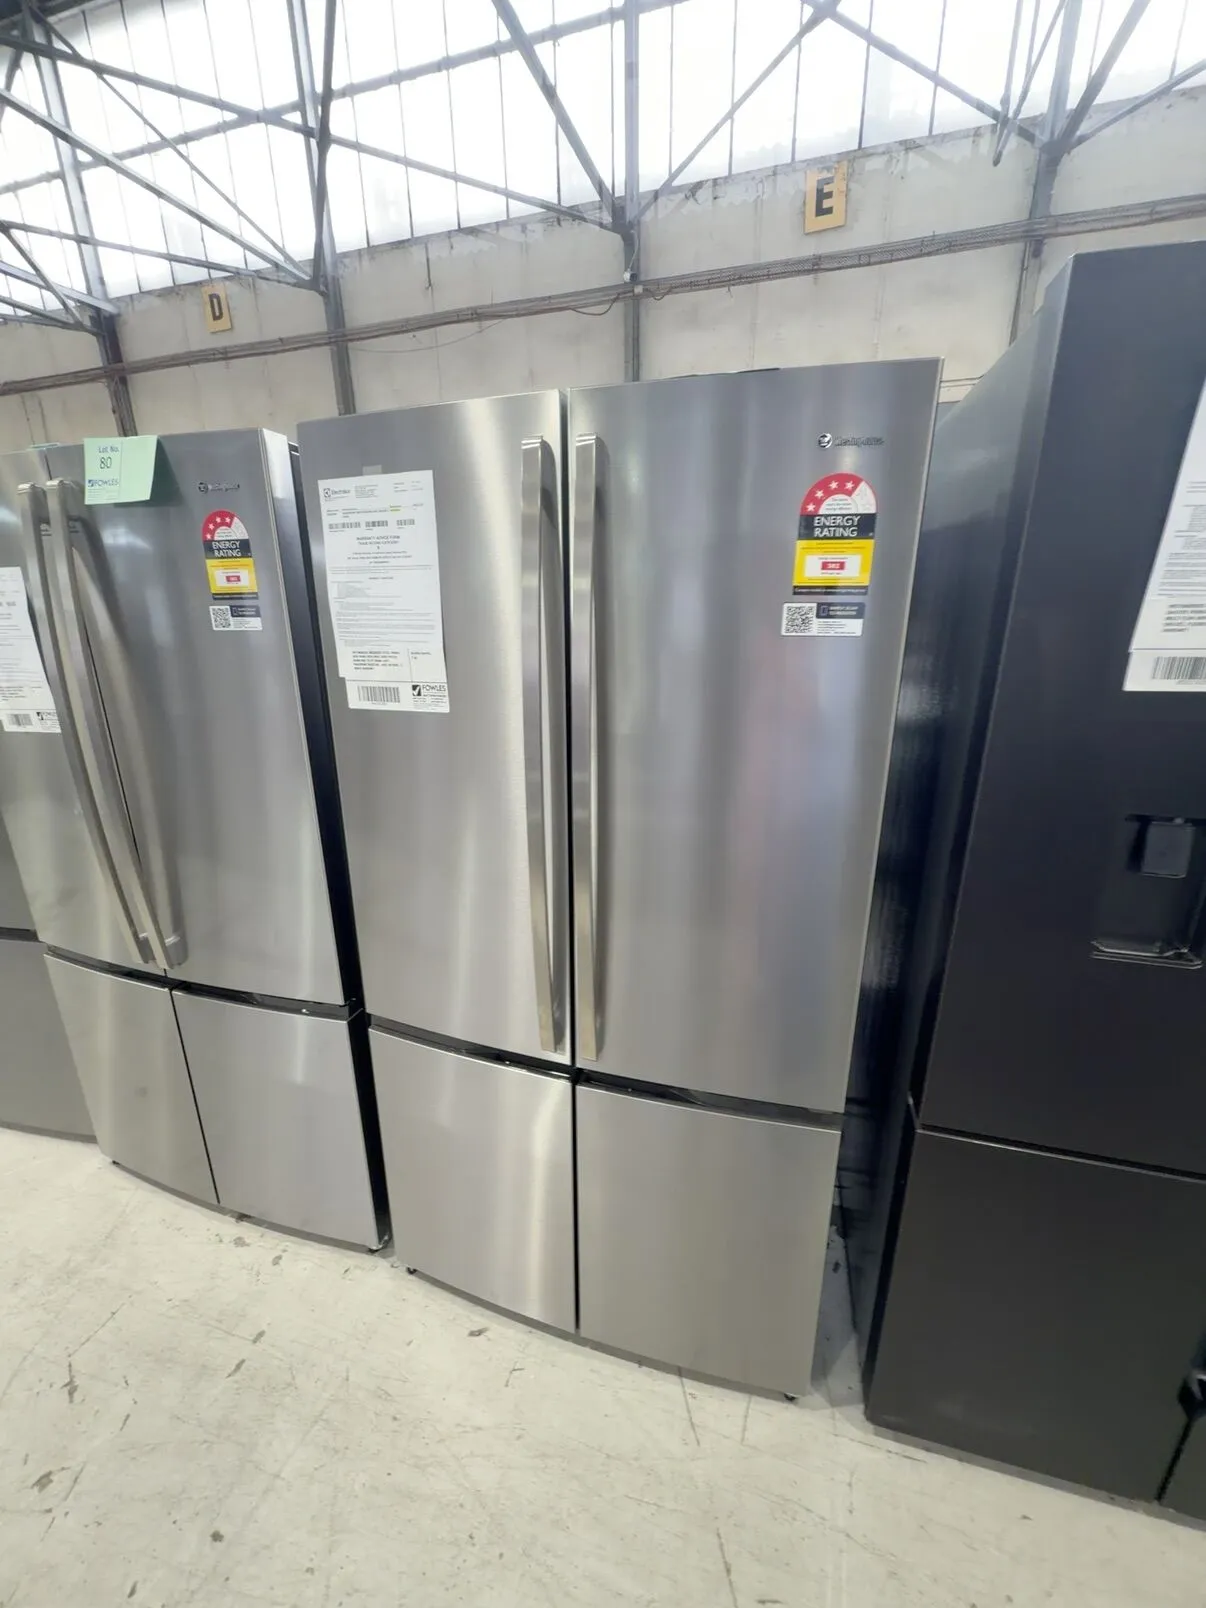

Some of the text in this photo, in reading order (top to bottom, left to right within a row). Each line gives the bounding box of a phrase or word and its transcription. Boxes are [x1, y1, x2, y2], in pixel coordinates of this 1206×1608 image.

[815, 175, 835, 217] E
[208, 293, 224, 321] D
[99, 456, 113, 470] 80
[813, 515, 861, 526] ENERGY
[813, 526, 858, 537] RATING
[212, 540, 241, 549] ENERGY
[213, 550, 242, 558] RATING
[422, 684, 447, 692] FOWLES
